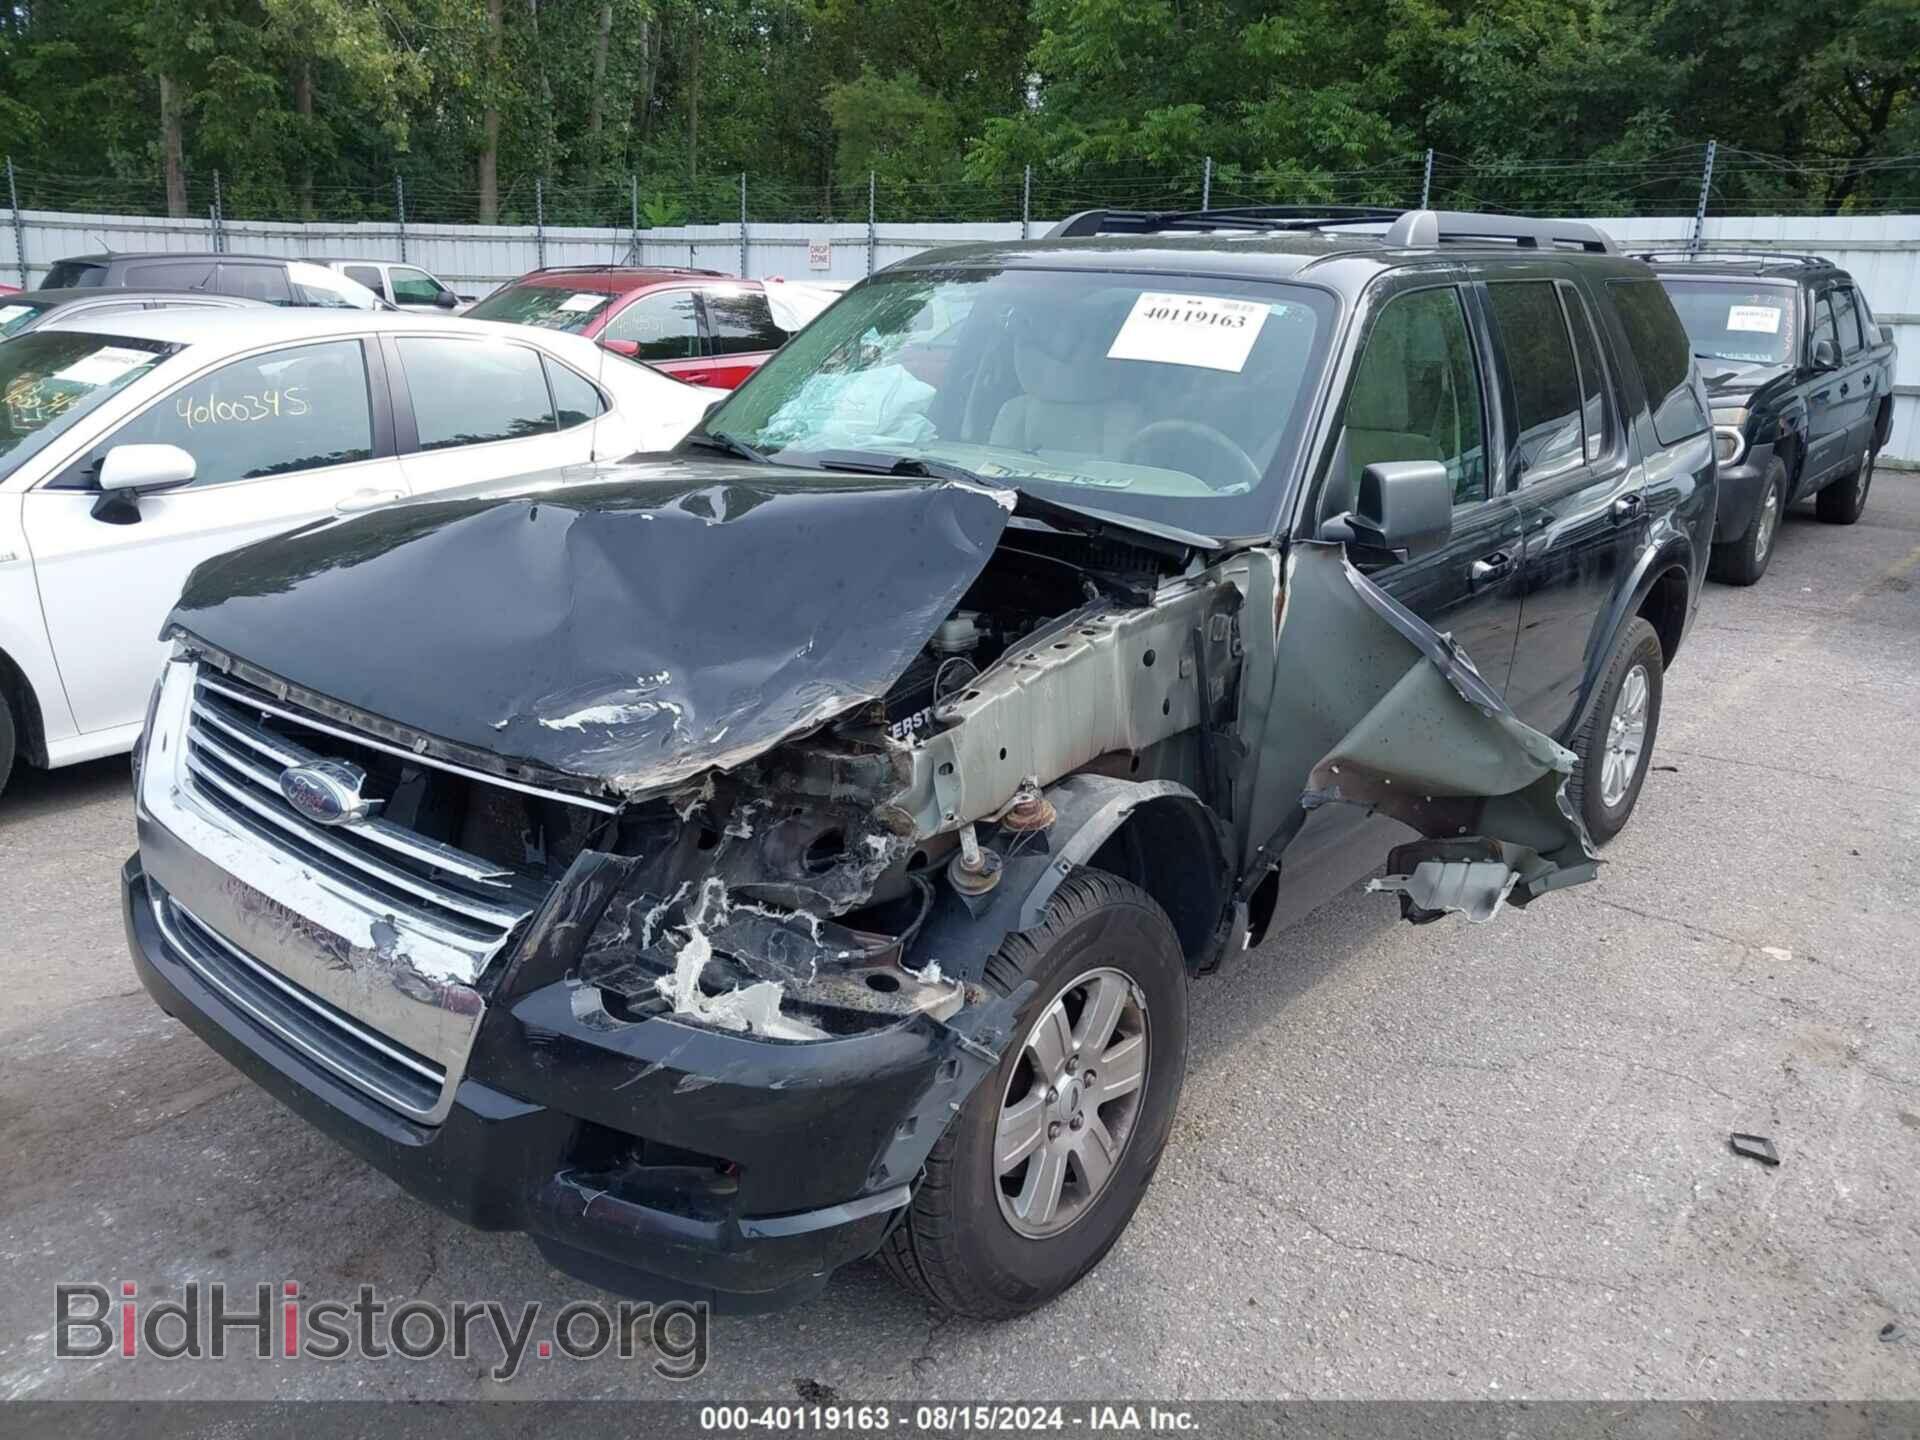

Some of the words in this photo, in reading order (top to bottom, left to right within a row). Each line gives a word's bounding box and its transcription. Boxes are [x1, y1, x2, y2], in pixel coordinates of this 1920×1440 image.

[810, 245, 828, 254] DROP
[810, 254, 828, 264] ZONE
[1144, 306, 1247, 329] 40119163
[176, 387, 309, 429] 40100345
